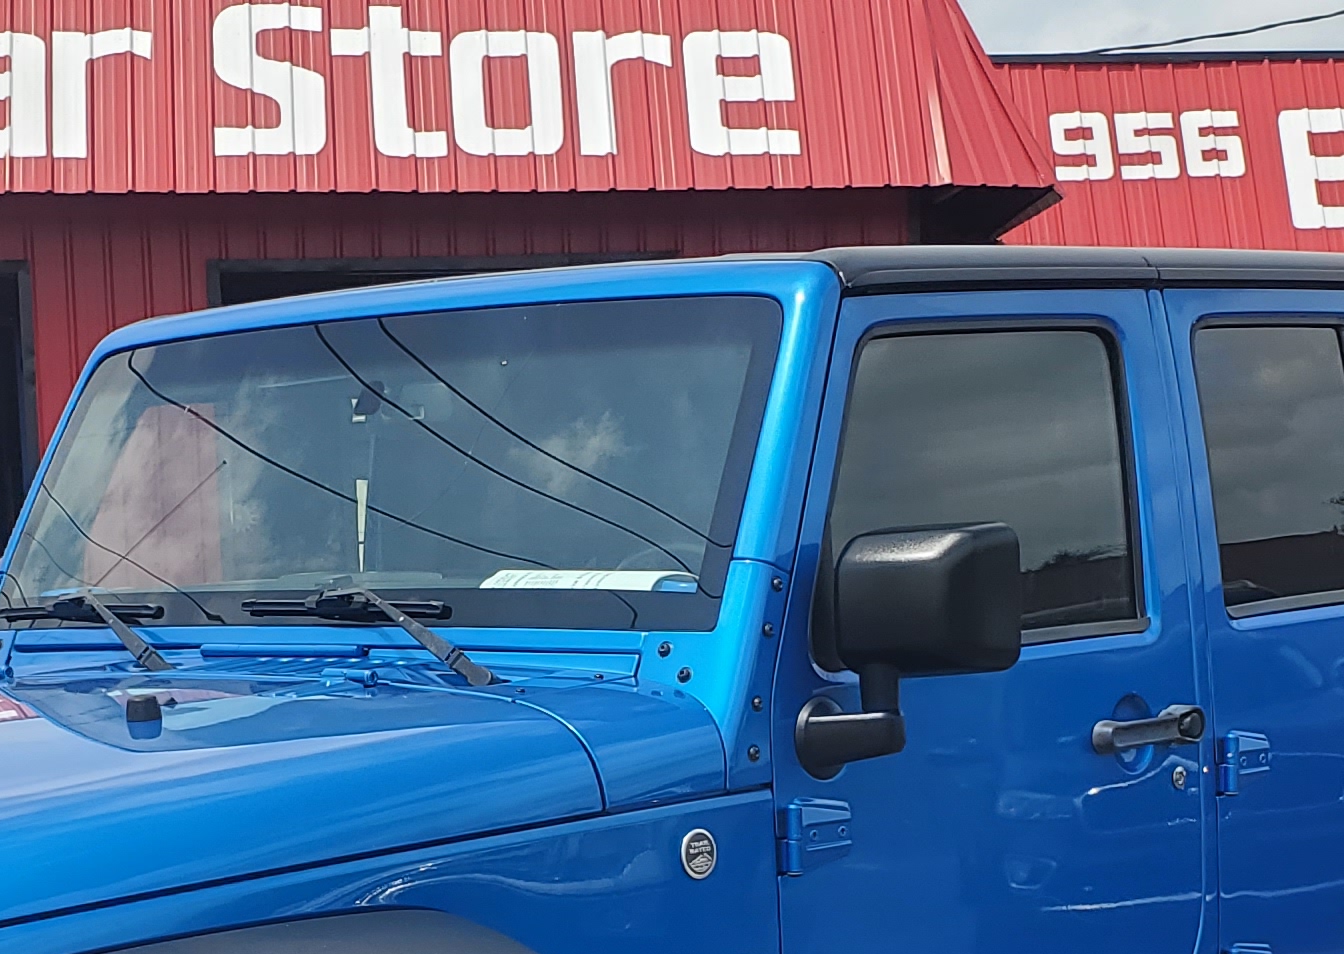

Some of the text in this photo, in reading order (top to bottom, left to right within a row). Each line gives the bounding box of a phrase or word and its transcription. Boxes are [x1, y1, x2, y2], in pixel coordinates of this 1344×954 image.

[213, 3, 801, 158] Store
[1050, 109, 1246, 182] 956
[689, 846, 711, 854] RATED
[690, 840, 710, 848] TRAIL
